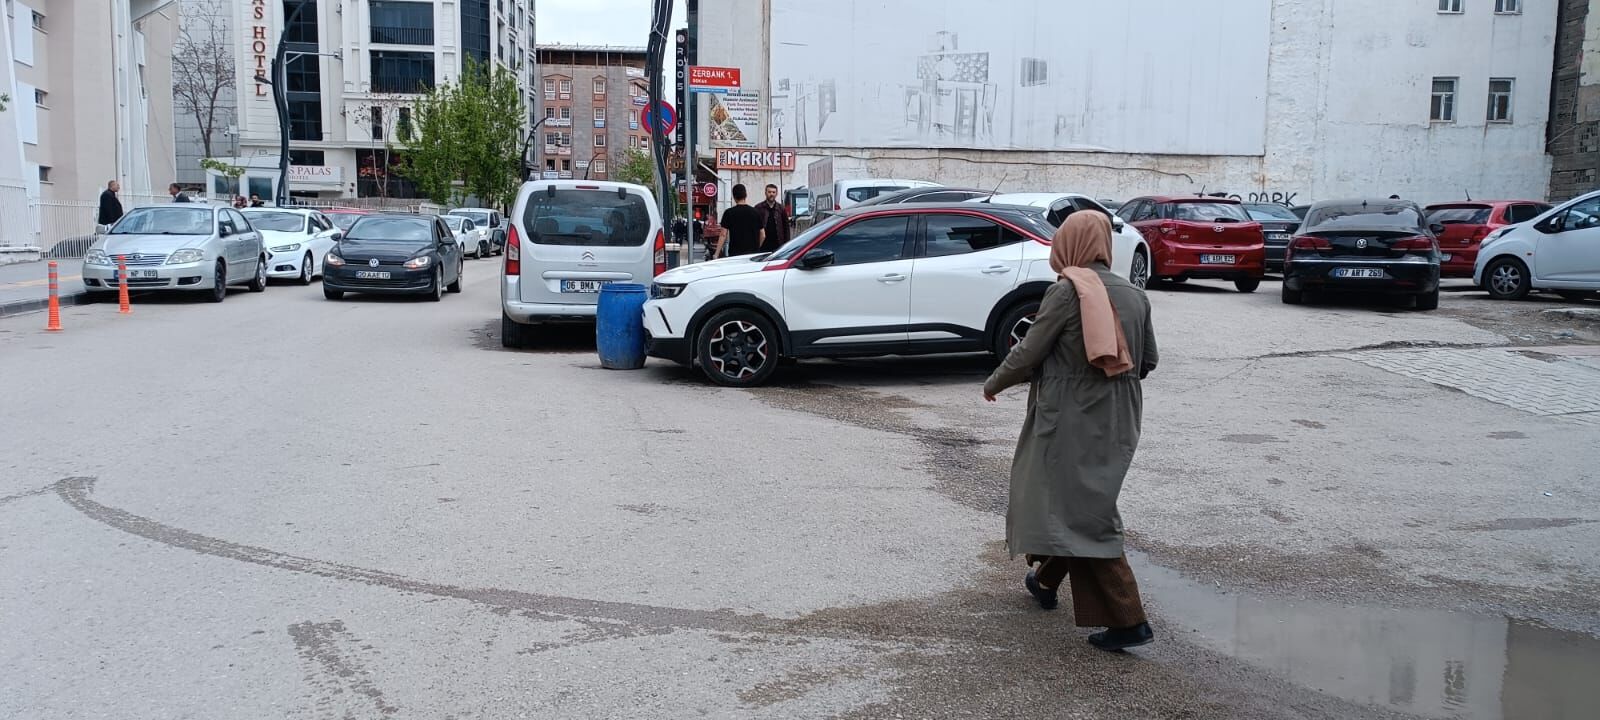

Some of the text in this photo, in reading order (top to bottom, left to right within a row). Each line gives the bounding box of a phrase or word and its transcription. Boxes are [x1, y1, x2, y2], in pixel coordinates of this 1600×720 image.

[252, 26, 267, 97] HOTEL
[692, 69, 726, 79] ZERBANK
[727, 150, 793, 167] MARKET
[297, 166, 332, 176] PALAS
[1249, 192, 1297, 207] PARK
[1351, 269, 1366, 277] ART
[566, 281, 576, 290] 06
[580, 281, 594, 290] BMA
